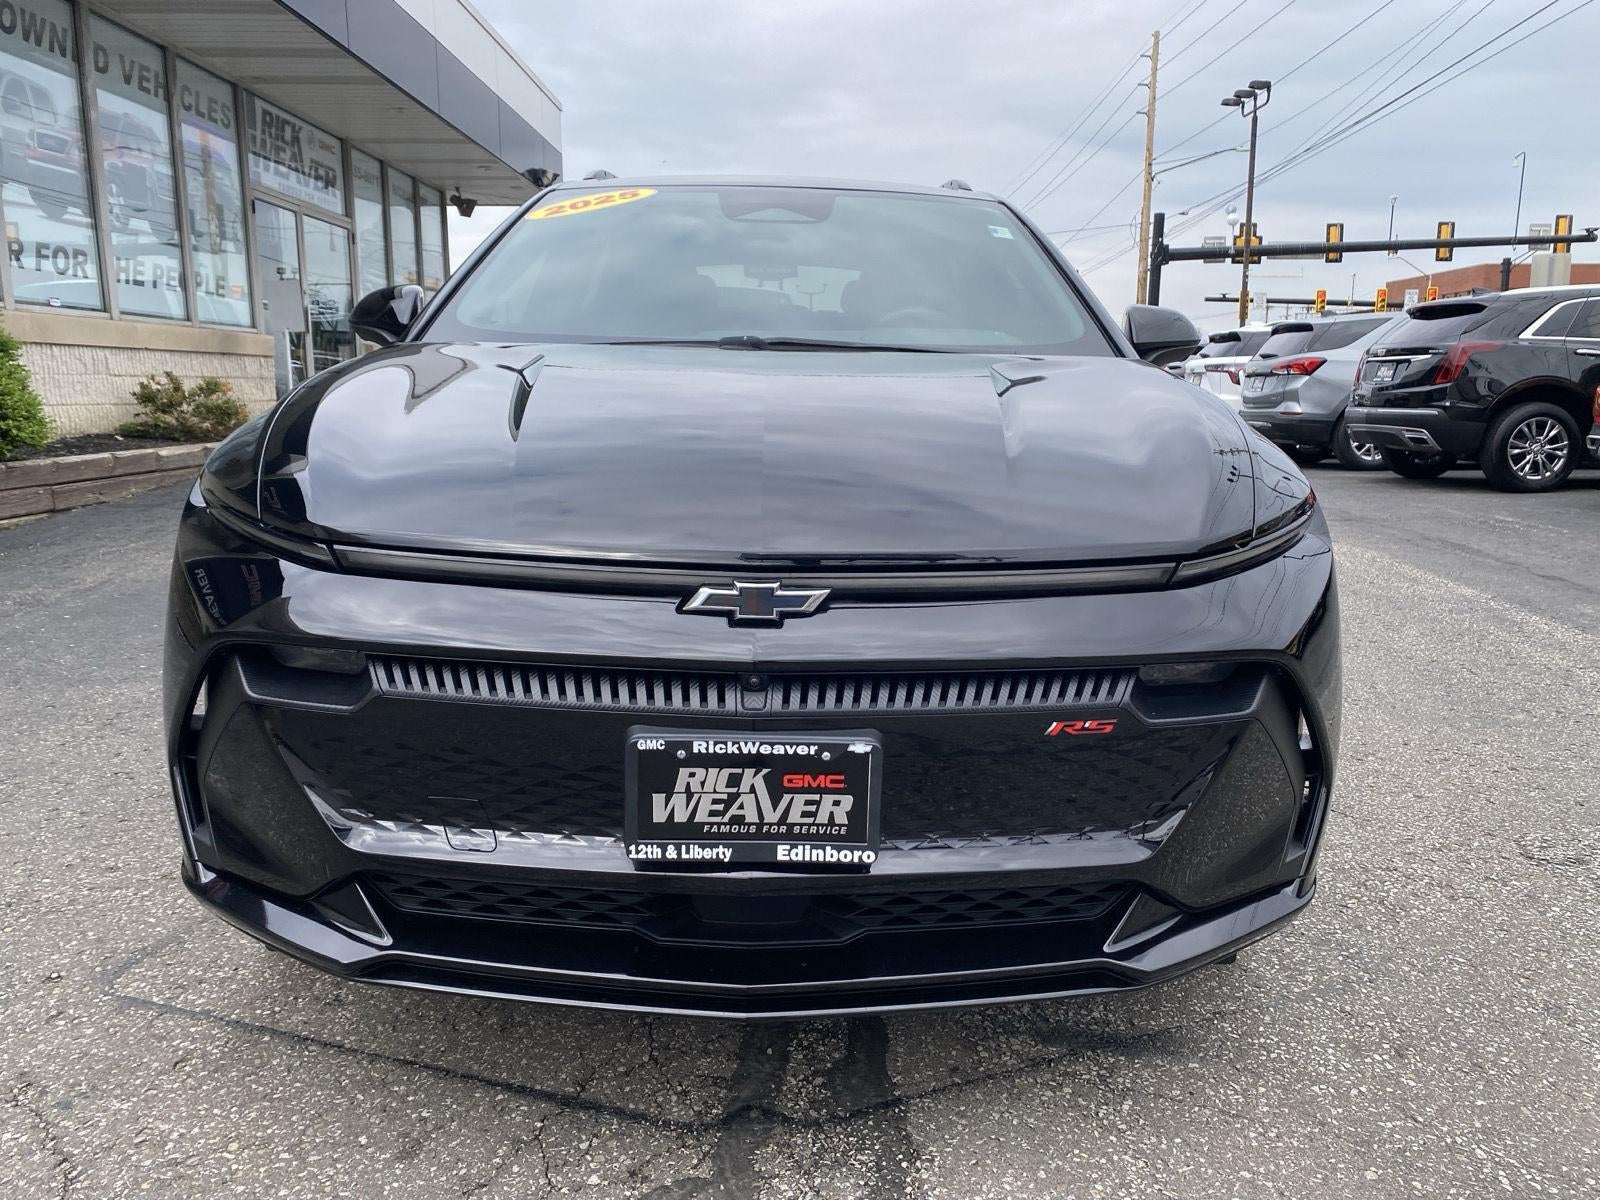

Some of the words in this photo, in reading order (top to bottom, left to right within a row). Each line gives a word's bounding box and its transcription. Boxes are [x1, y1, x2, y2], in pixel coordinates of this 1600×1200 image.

[0, 1, 110, 75] OWND
[119, 53, 232, 129] VEHCLES
[543, 189, 642, 217] 2025
[35, 241, 89, 278] FOR
[114, 256, 146, 287] HE
[1043, 718, 1119, 737] RS
[636, 739, 666, 751] GMC
[673, 767, 772, 794] RICK
[782, 774, 848, 789] GMC
[652, 793, 854, 825] WEAVER
[703, 824, 757, 834] FAMOUS
[762, 825, 787, 834] FOR
[793, 825, 848, 835] SERVICE
[628, 844, 663, 860] 12th
[665, 844, 678, 860] &
[681, 844, 733, 863] Liberty
[776, 844, 876, 864] Edinboro
